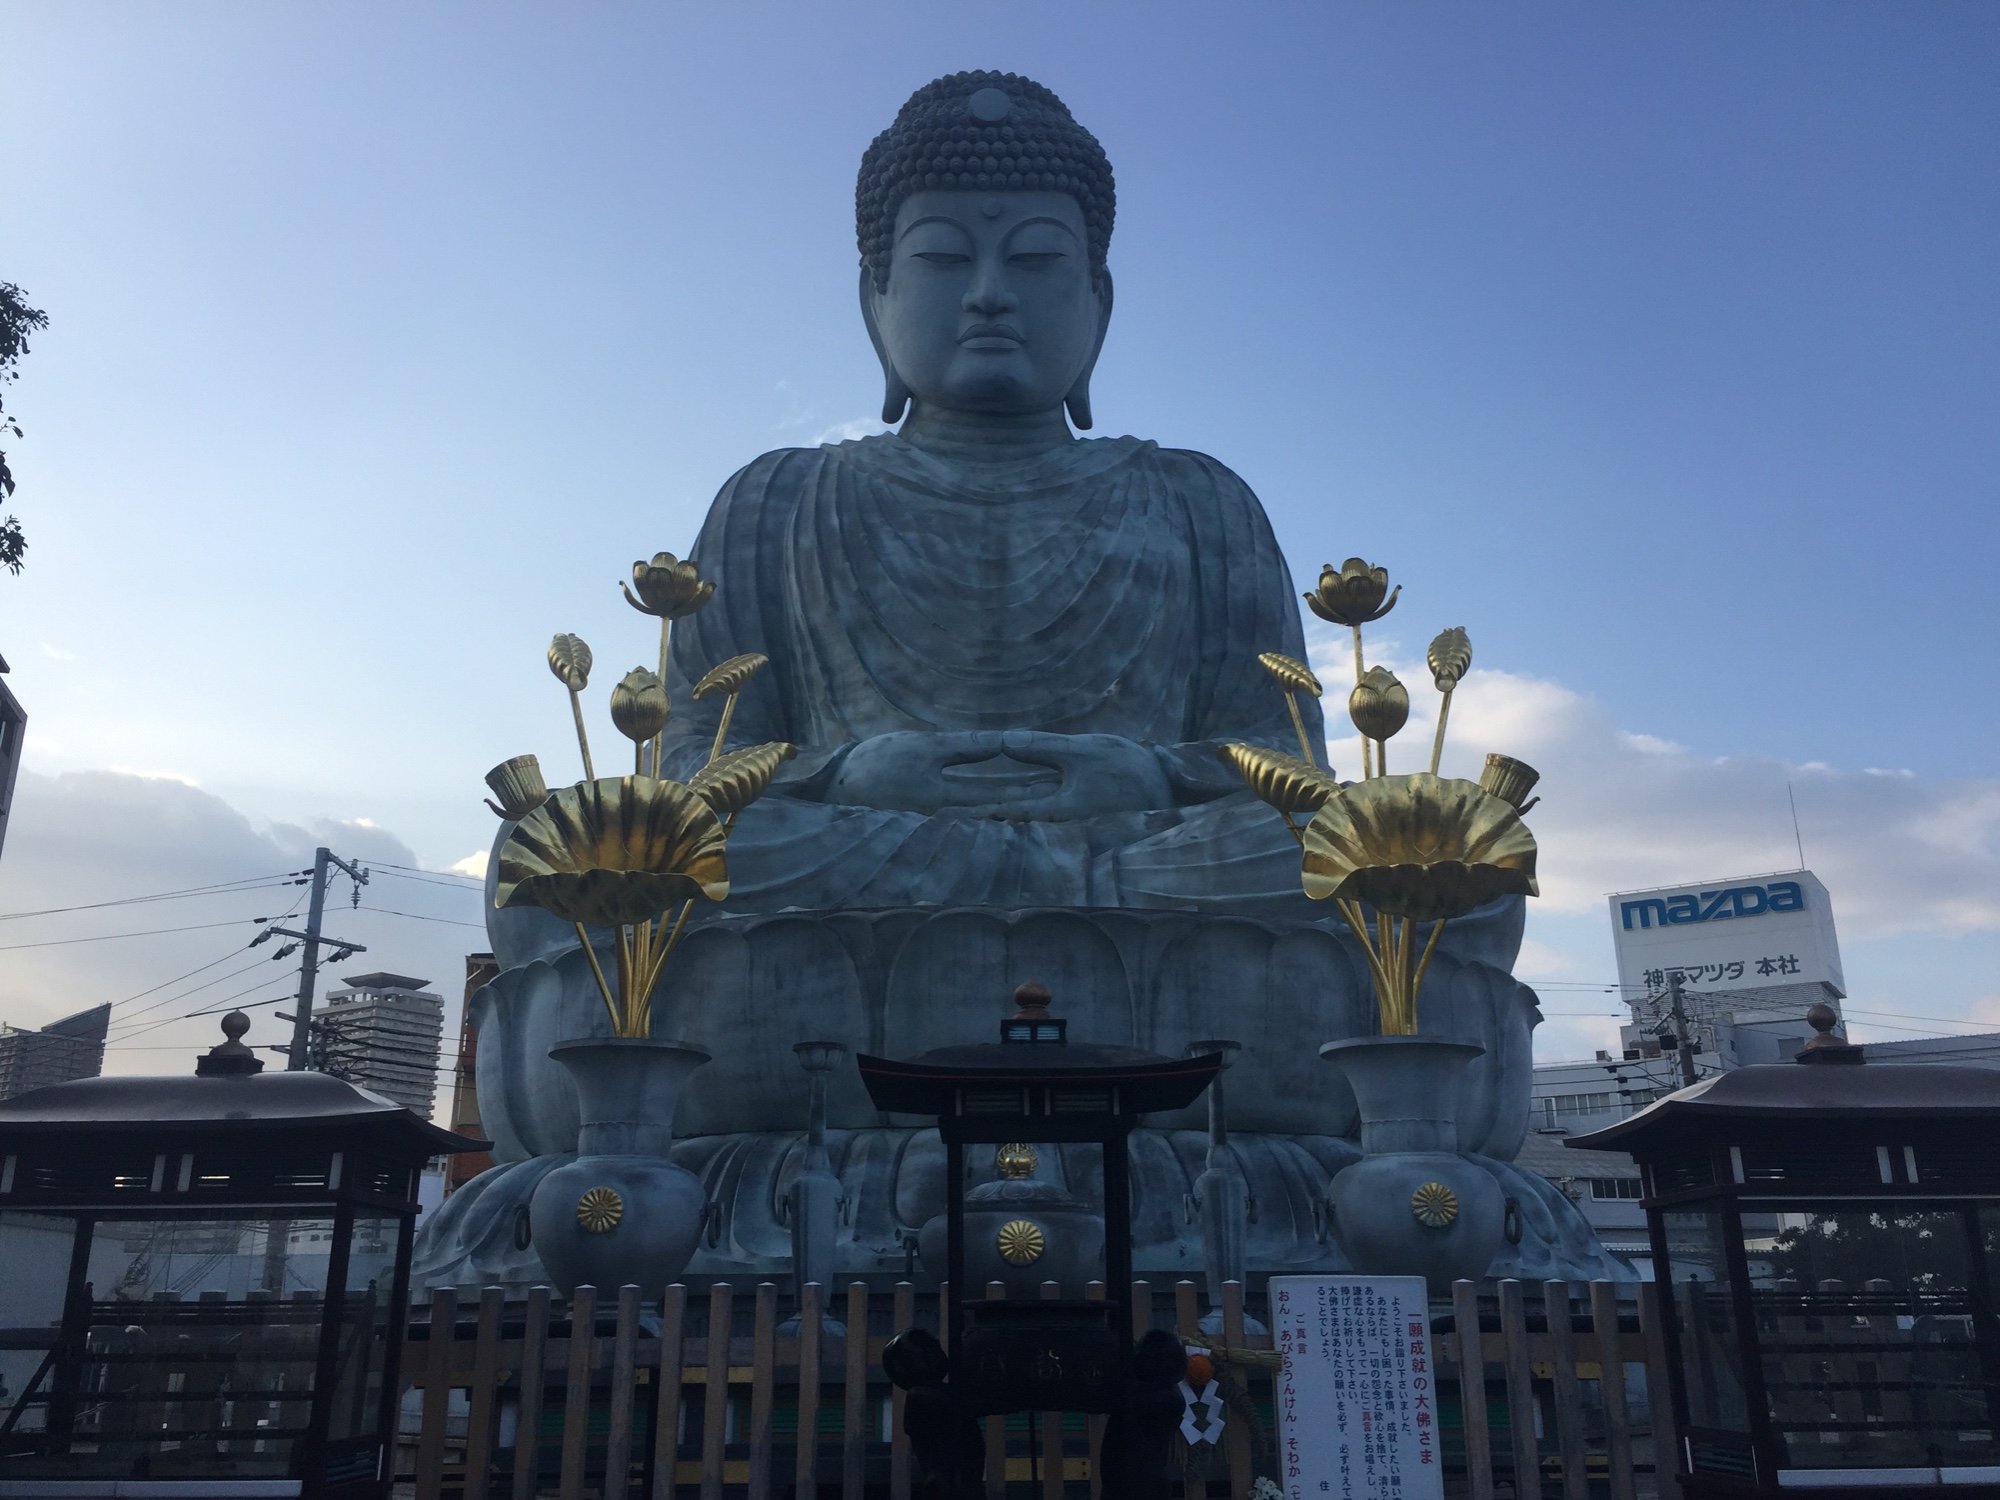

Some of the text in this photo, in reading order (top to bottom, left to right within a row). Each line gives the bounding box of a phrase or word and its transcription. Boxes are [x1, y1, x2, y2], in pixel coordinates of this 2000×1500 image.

[1755, 954, 1801, 977] 本社
[1295, 1312, 1308, 1355] ご真言
